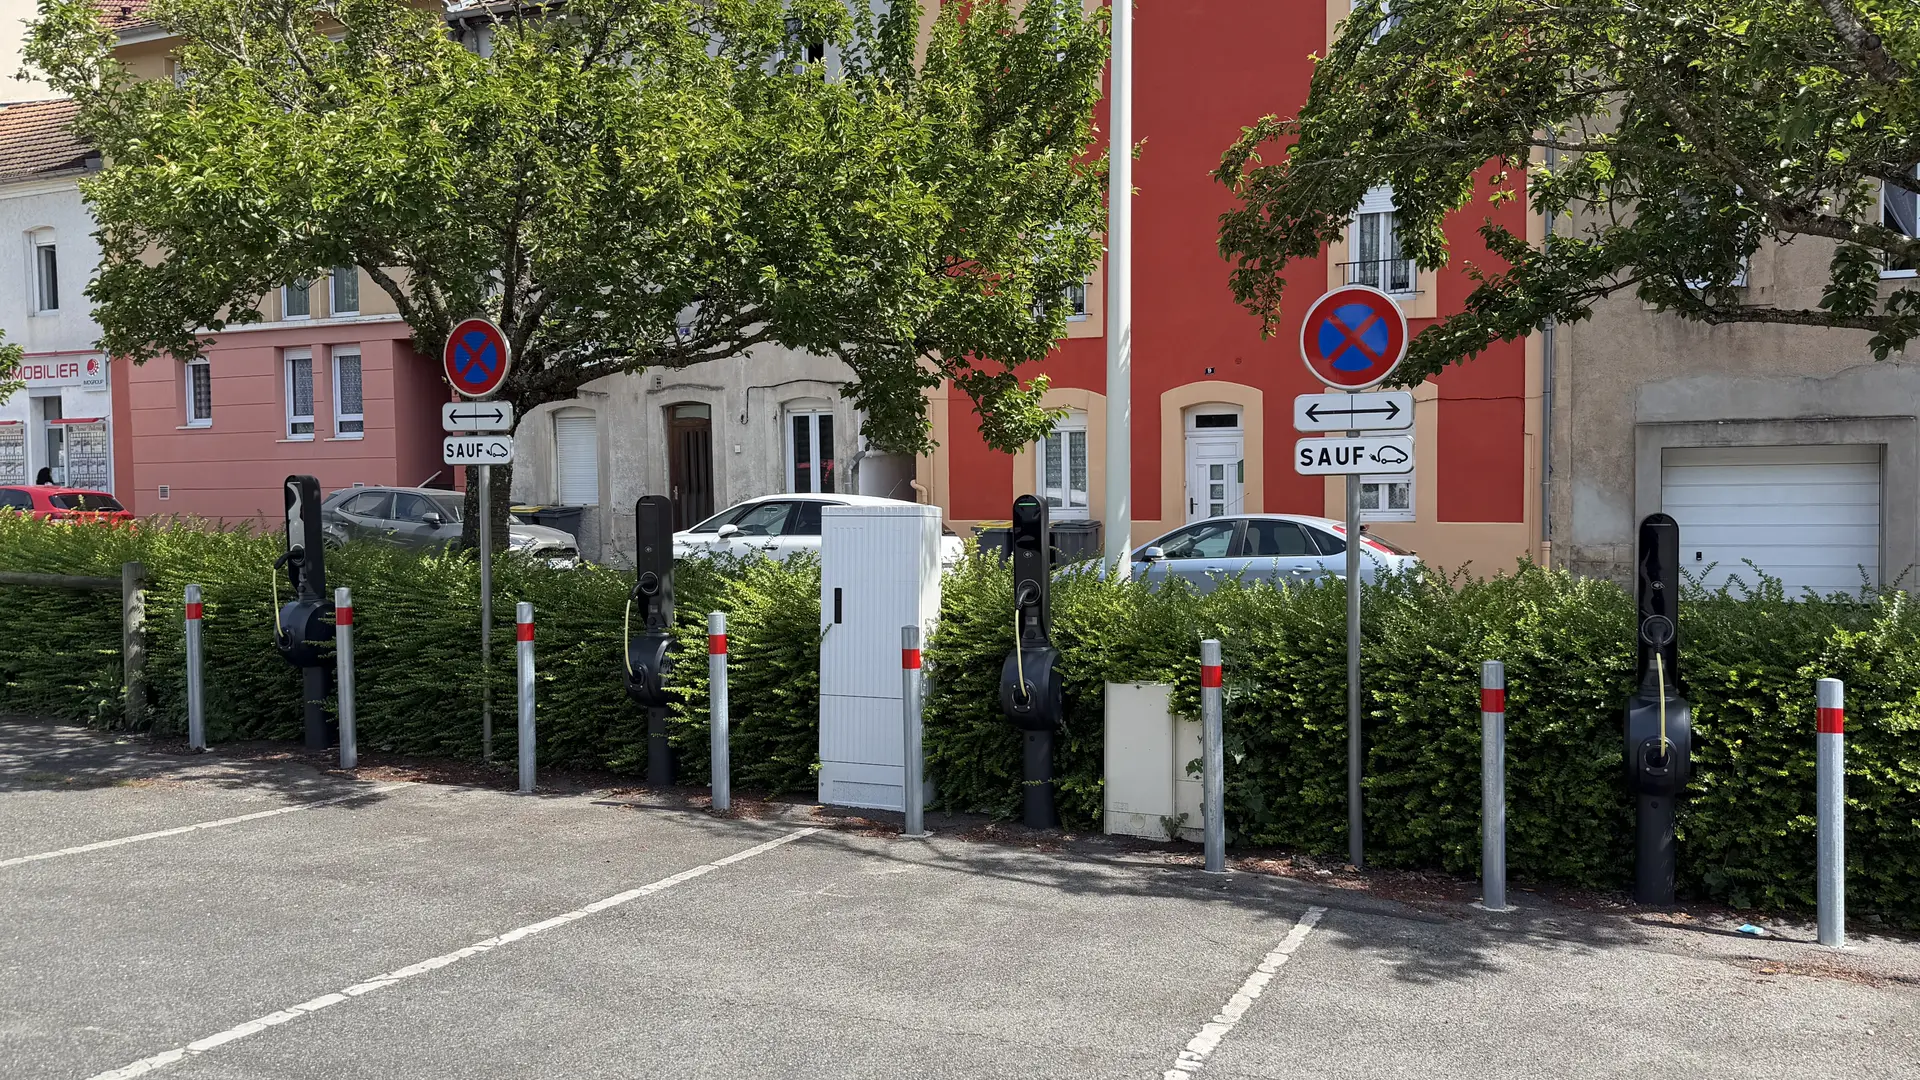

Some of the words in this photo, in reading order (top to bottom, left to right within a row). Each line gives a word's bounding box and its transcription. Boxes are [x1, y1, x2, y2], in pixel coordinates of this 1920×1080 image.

[11, 363, 79, 381] MOBILIER
[446, 443, 483, 458] SAUF
[1300, 446, 1365, 466] SAUF
